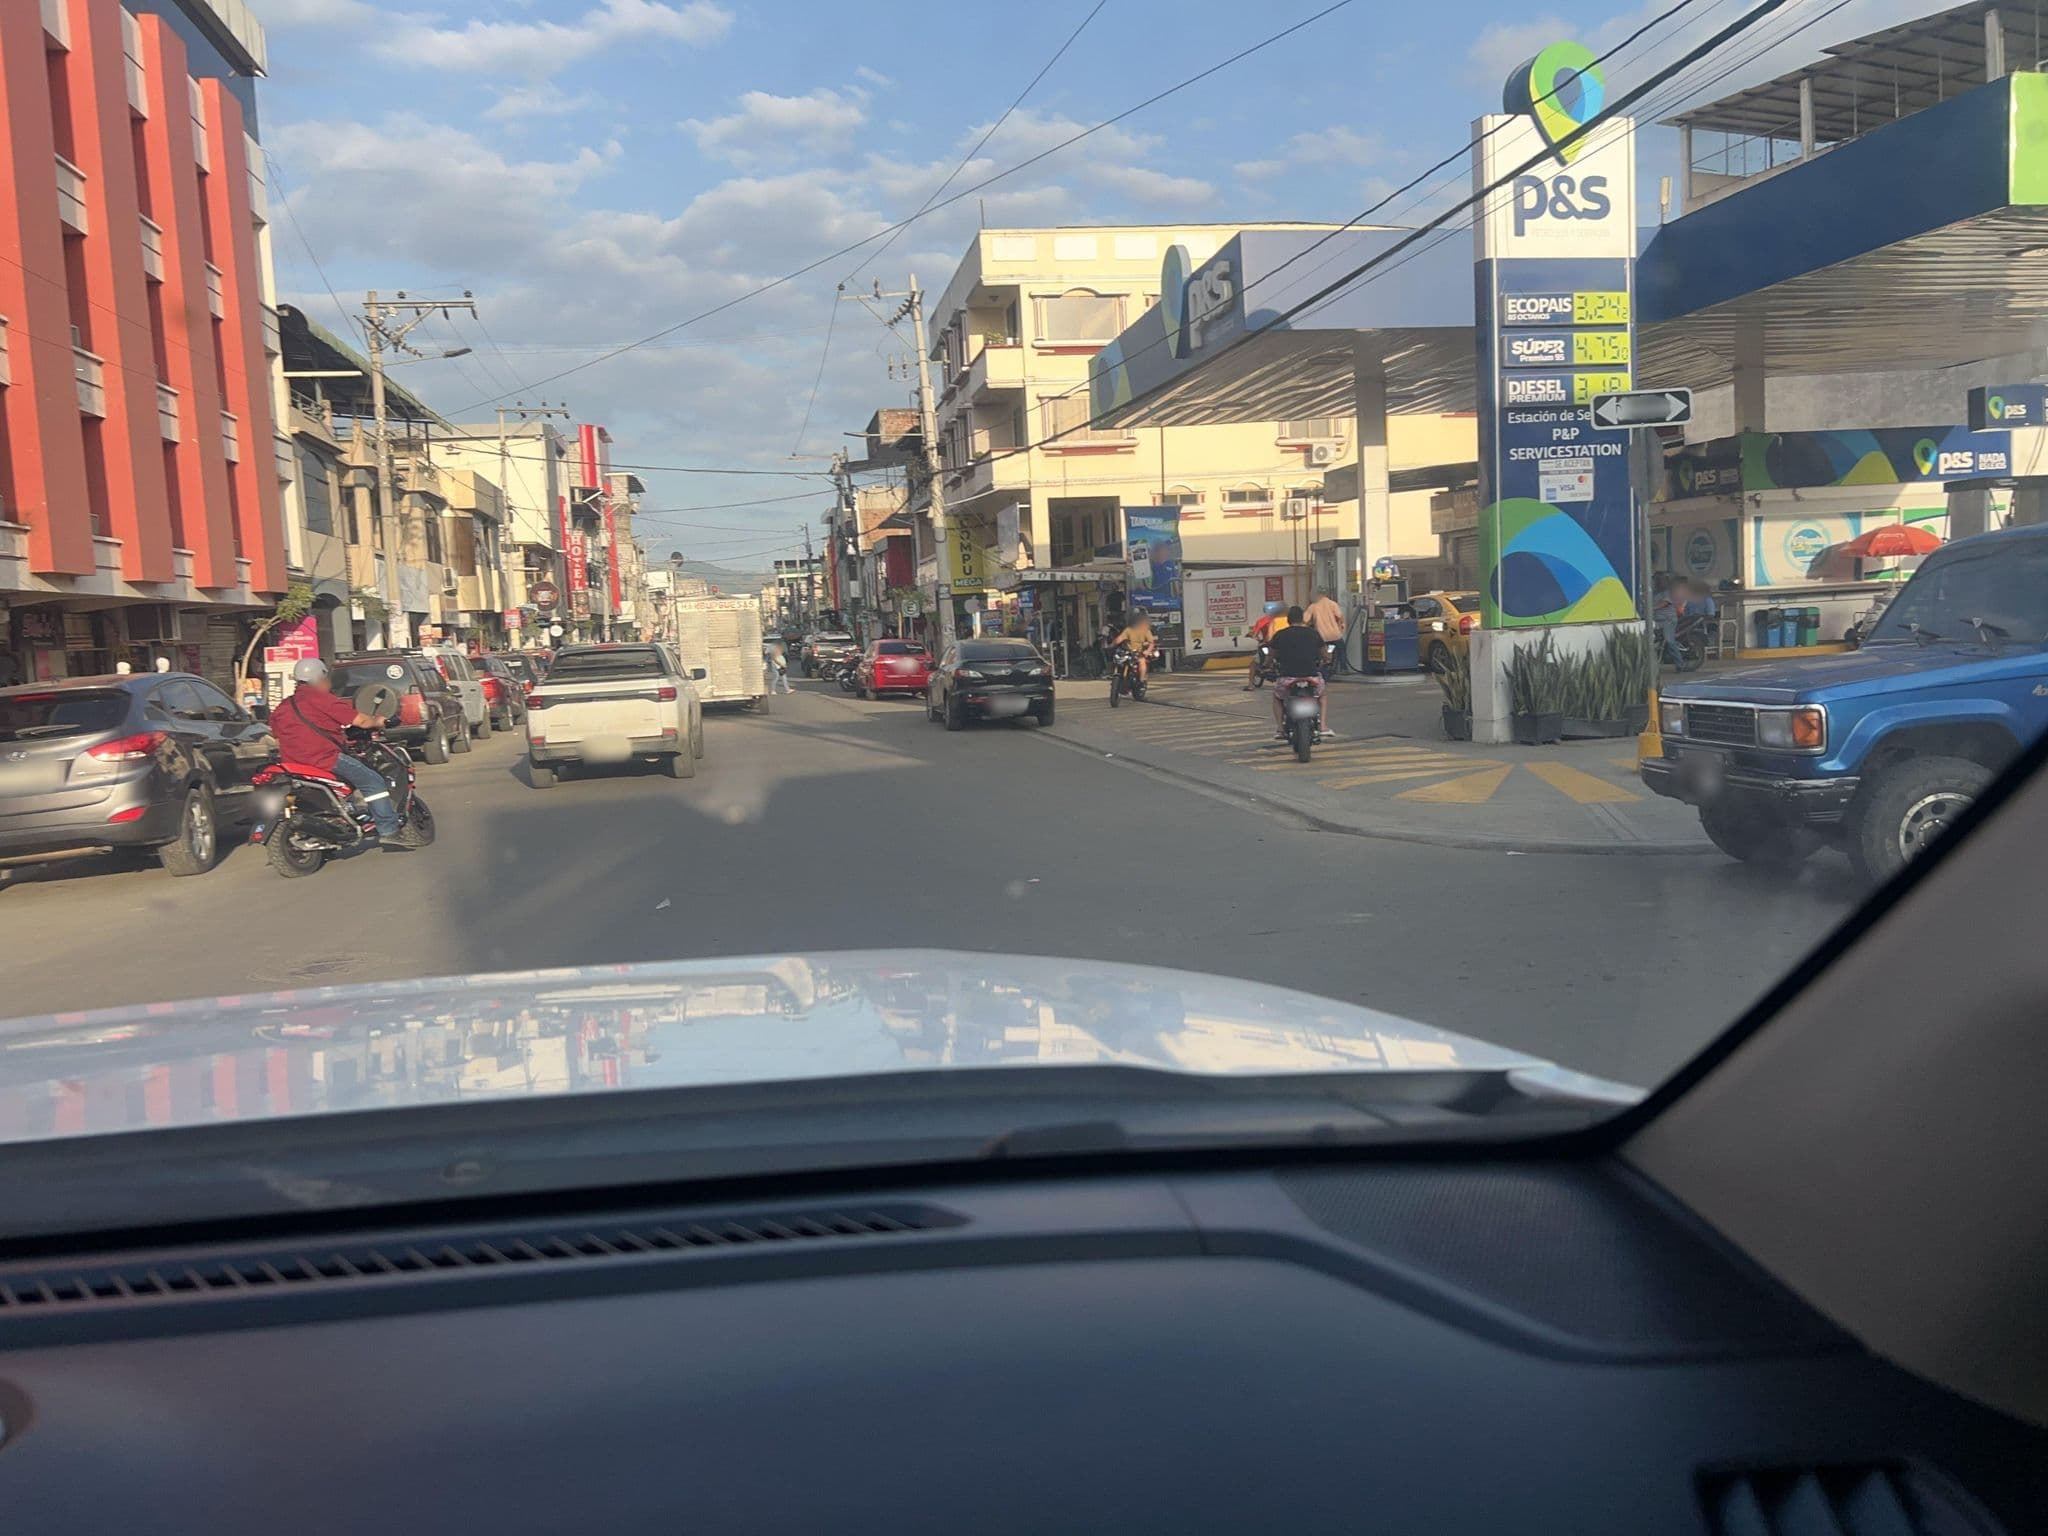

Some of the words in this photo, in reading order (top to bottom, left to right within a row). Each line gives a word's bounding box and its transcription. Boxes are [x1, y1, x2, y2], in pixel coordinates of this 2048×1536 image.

[1507, 297, 1572, 314] ECOPAIS
[1508, 379, 1566, 395] DIESEL
[1508, 393, 1566, 403] PREMIUM
[1507, 410, 1558, 424] Estación
[1559, 409, 1574, 422] de
[1552, 428, 1580, 441] P&P
[1509, 444, 1622, 461] SERVICESTATION
[571, 534, 583, 590] HOTEL
[1192, 638, 1202, 650] 2
[1231, 637, 1238, 648] 1
